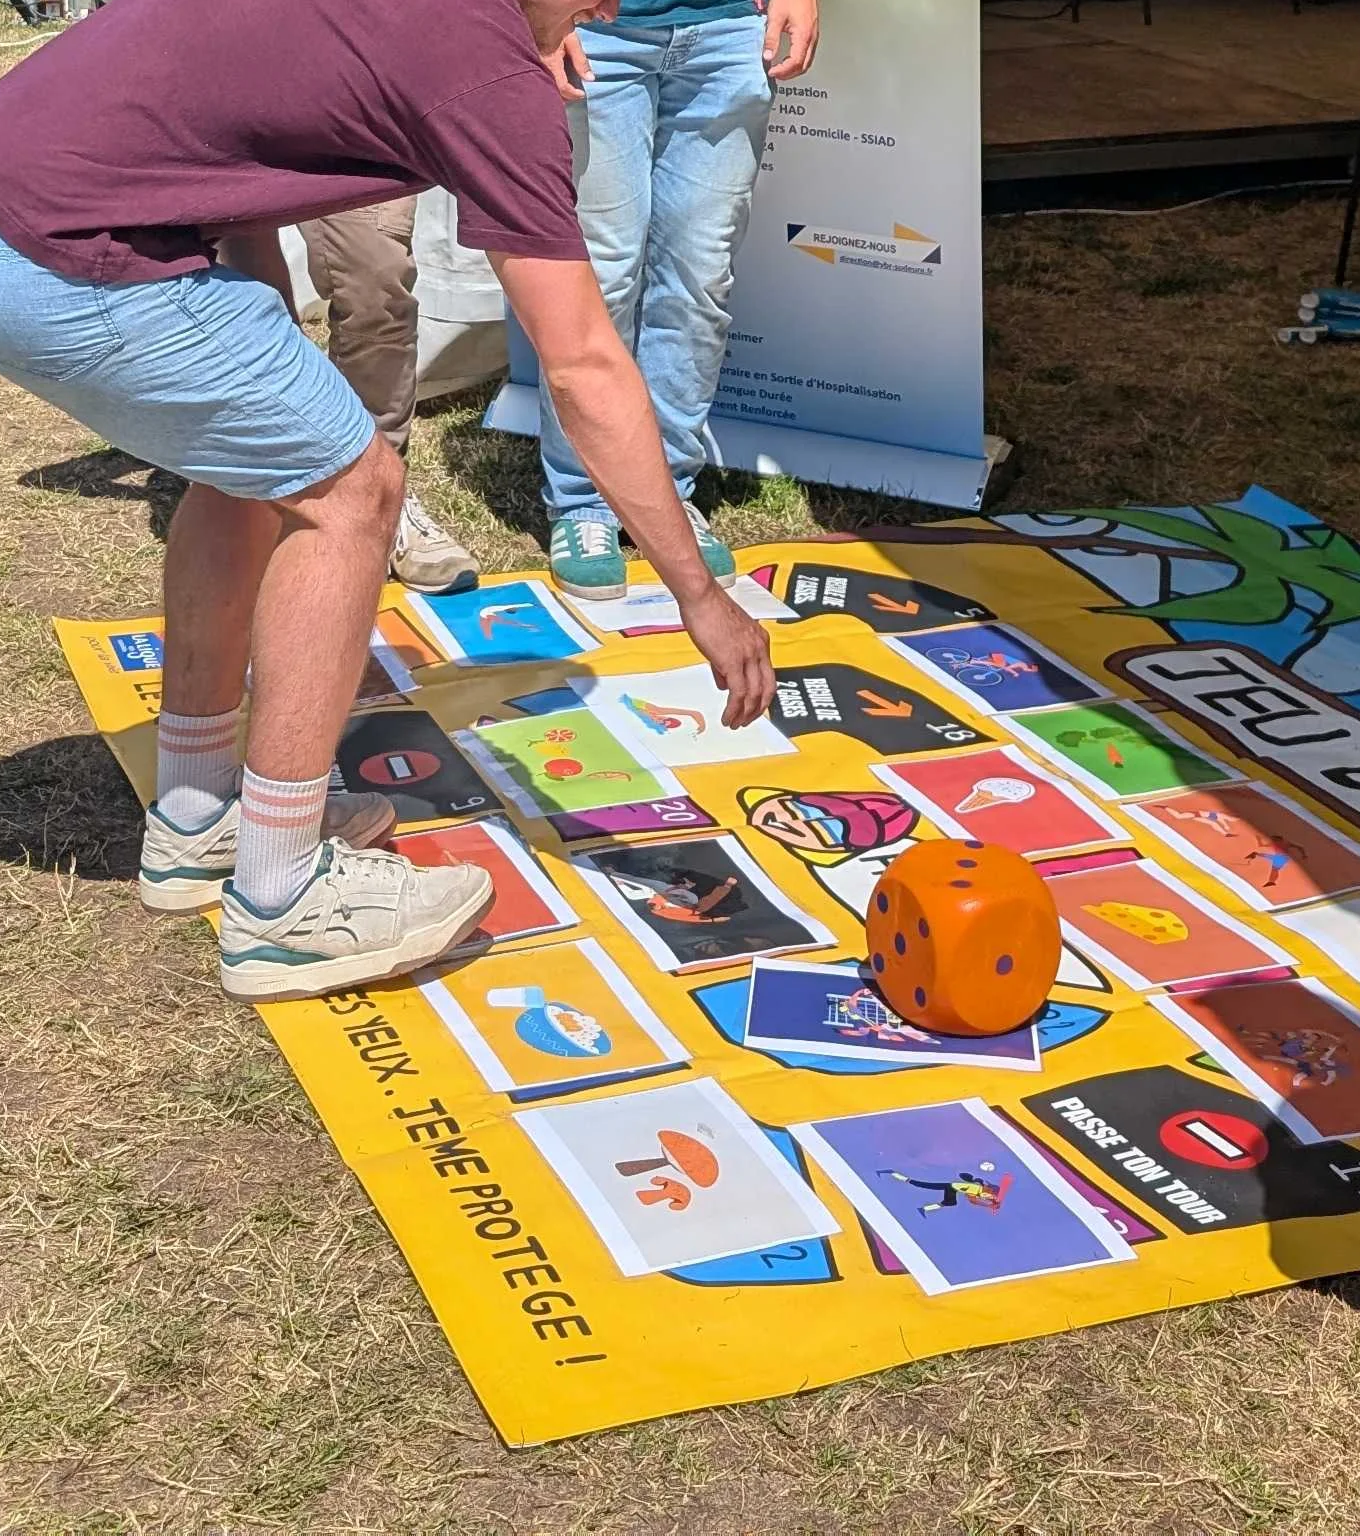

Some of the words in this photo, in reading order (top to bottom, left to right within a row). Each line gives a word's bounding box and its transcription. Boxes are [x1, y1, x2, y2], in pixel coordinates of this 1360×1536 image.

[779, 104, 806, 116] HAD
[788, 124, 797, 134] A
[800, 125, 851, 142] Domicile
[860, 133, 896, 148] SSIAD
[813, 232, 897, 254] REJOIGNEZ-NOUS
[754, 373, 767, 382] en
[771, 372, 803, 386] Sortie
[718, 383, 757, 400] Longue
[759, 389, 793, 403] Durée
[741, 403, 797, 421] Renforcée
[954, 607, 985, 619] 5
[777, 684, 808, 718] CASES
[803, 677, 834, 707] RECULE
[1146, 655, 1351, 747] JEU
[815, 704, 842, 722] DE
[926, 721, 977, 742] 18
[651, 800, 698, 822] 20
[1051, 1096, 1129, 1149] PASSE
[1112, 1146, 1172, 1183] TON
[1155, 1179, 1228, 1225] TOUR
[760, 1245, 808, 1269] 2
